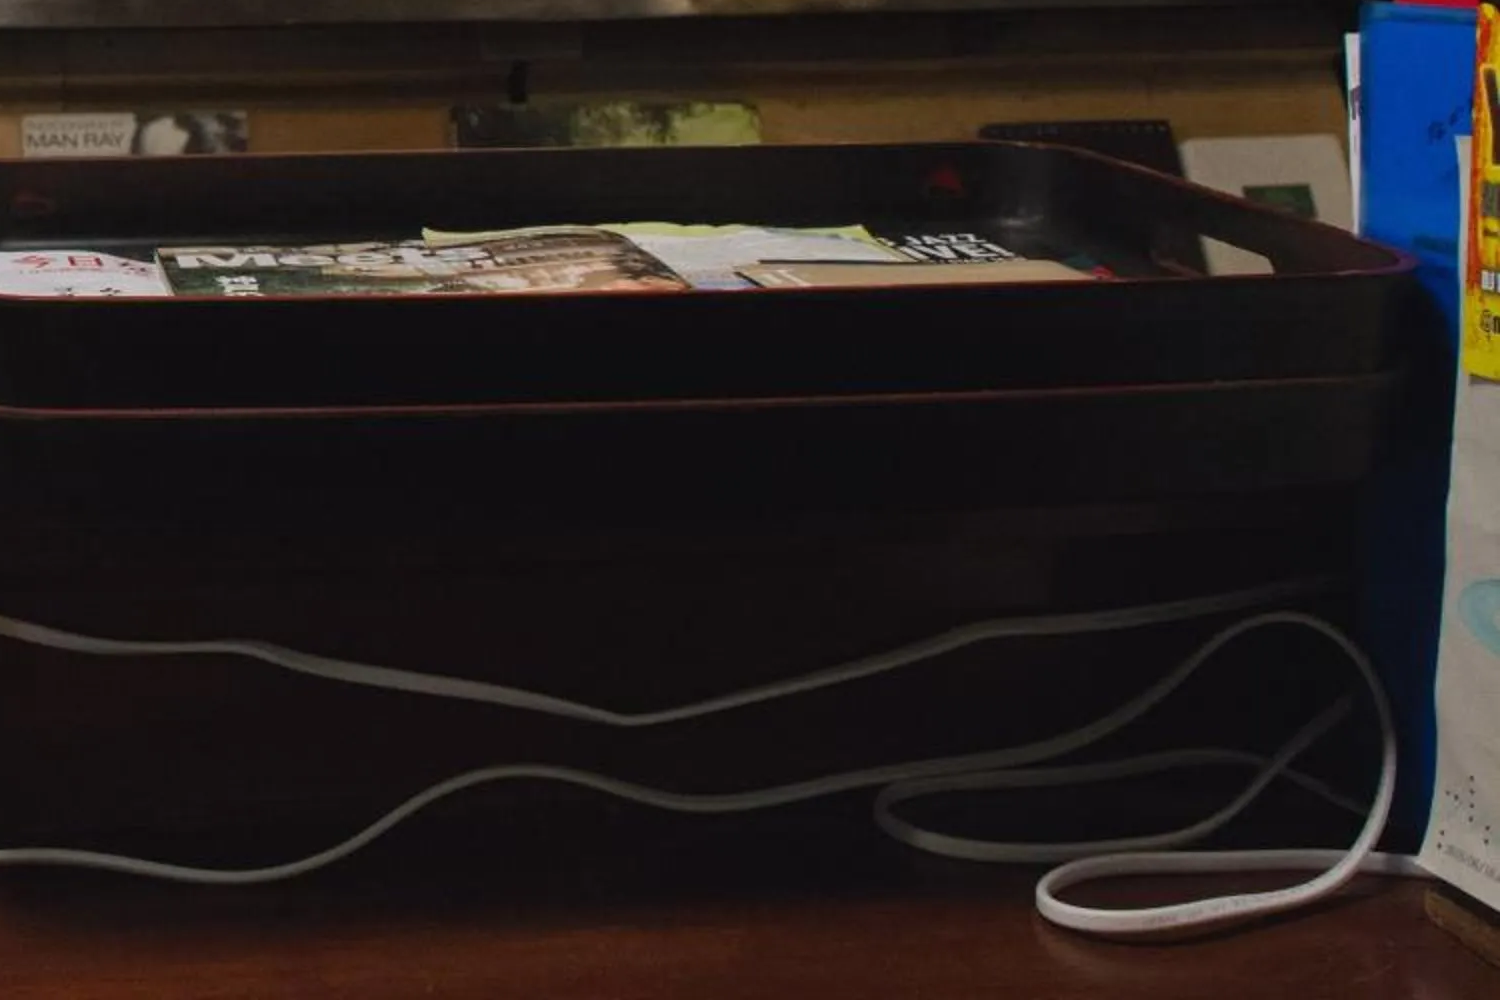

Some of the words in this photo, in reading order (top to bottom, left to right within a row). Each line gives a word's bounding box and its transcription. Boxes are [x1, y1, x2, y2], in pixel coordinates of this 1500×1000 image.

[26, 133, 79, 149] MAN
[83, 132, 124, 148] RAY
[903, 233, 988, 247] JAZZ
